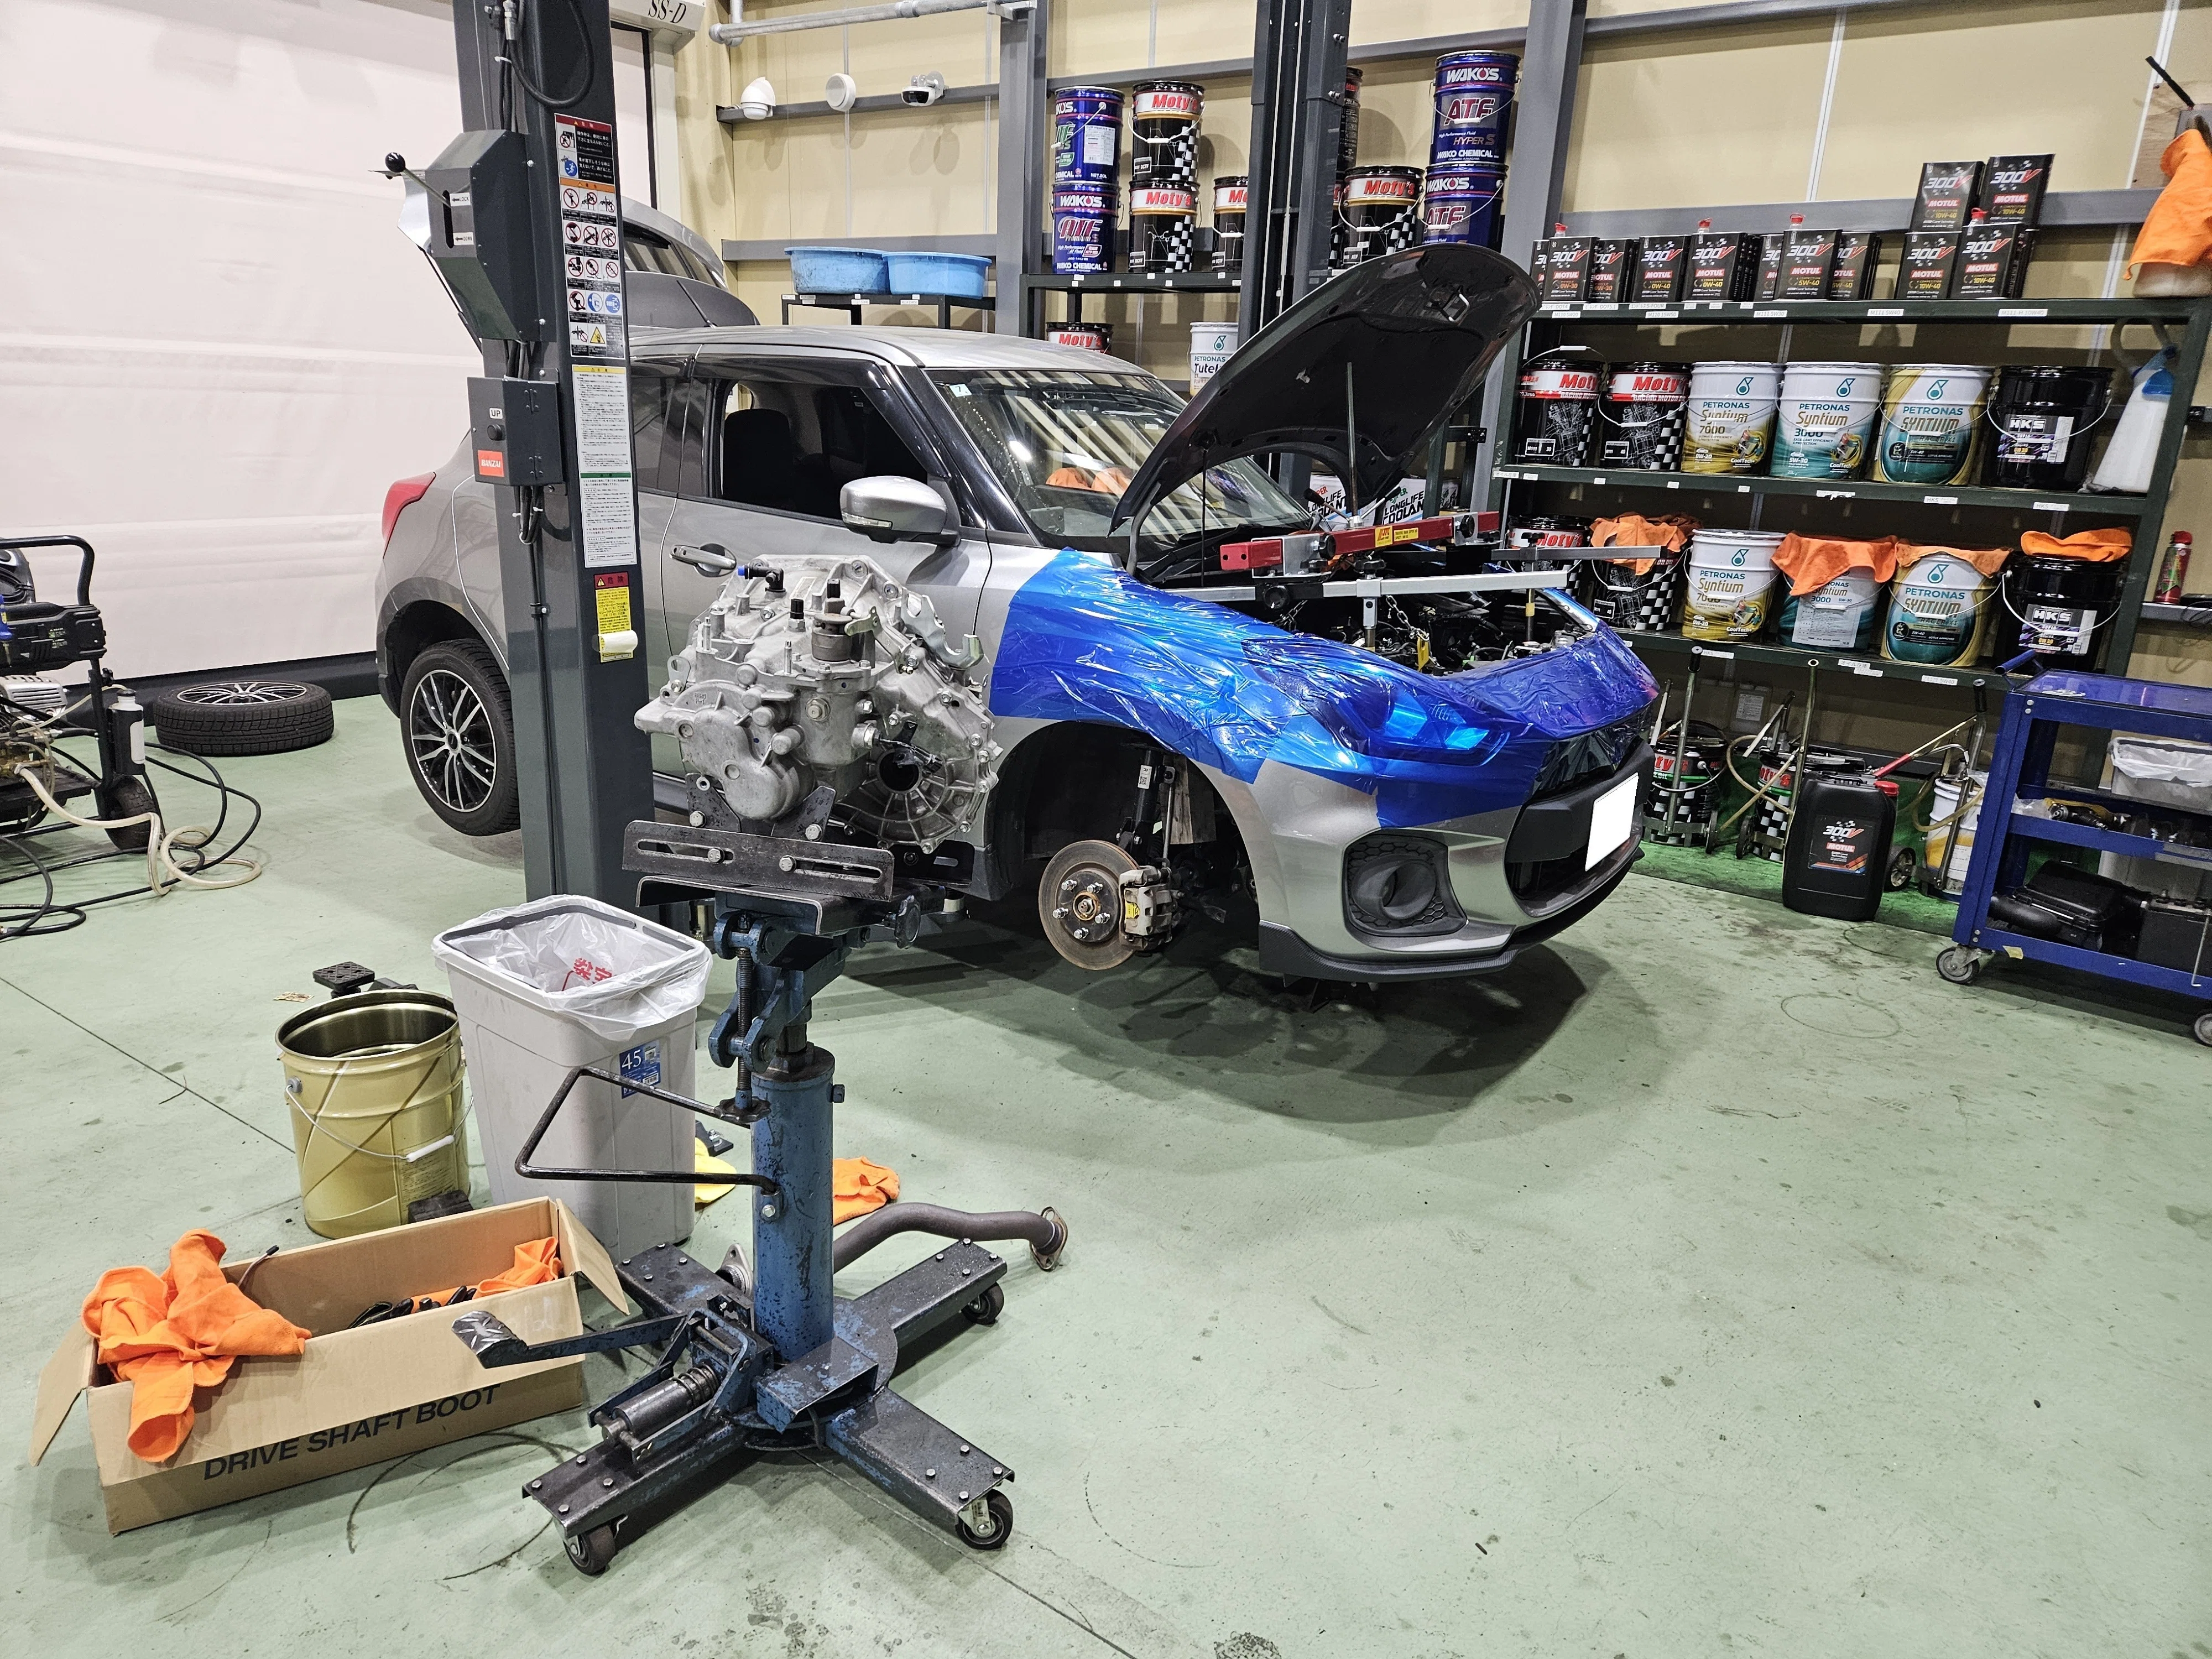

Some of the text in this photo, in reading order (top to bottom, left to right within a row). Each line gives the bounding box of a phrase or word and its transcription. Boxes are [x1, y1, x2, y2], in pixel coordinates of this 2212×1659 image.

[1447, 67, 1499, 84] WAKO'S
[1152, 95, 1198, 111] Moty's
[1444, 98, 1495, 126] ATF
[1453, 137, 1484, 145] HYPER
[1437, 149, 1493, 159] WAKO CHEMICAL
[1924, 175, 1974, 189] 300V
[1990, 169, 2043, 184] 300V
[1364, 180, 1416, 196] Moty's
[1427, 178, 1470, 193] WAKO'S
[1060, 195, 1103, 207] WAKO'S
[1145, 192, 1192, 207] Moty's
[1994, 195, 2028, 204] MOTUL
[1424, 206, 1467, 234] ATF
[1060, 218, 1103, 238] ATF
[1692, 246, 1736, 259] 300V
[1787, 243, 1834, 257] 300V
[1907, 246, 1956, 260] 300V
[1962, 238, 2012, 254] 300V
[1550, 249, 1590, 262] 300V
[1641, 249, 1683, 262] 300V
[1965, 264, 1997, 272] MOTUL
[1059, 333, 1102, 348] Moty's
[1194, 363, 1218, 373] Tutel
[1559, 374, 1599, 391] Moty
[1903, 406, 1963, 415] PETRONAS
[1796, 411, 1848, 427] Syntium
[2010, 419, 2045, 429] HKS
[1699, 426, 1725, 434] 7000
[481, 459, 501, 468] BANZAI
[1384, 490, 1425, 515] LONGLIFE
[1383, 499, 1425, 525] COOLAN
[1700, 571, 1745, 580] PETRONAS
[1698, 578, 1744, 593] Syntium
[1906, 587, 1965, 599] PETRONAS
[2033, 609, 2071, 623] HKS
[1823, 825, 1865, 838] 300V
[1827, 842, 1855, 853] MOTUL
[622, 1049, 641, 1070] 45
[204, 1383, 502, 1481] DRIVE SHAFT BOOT
